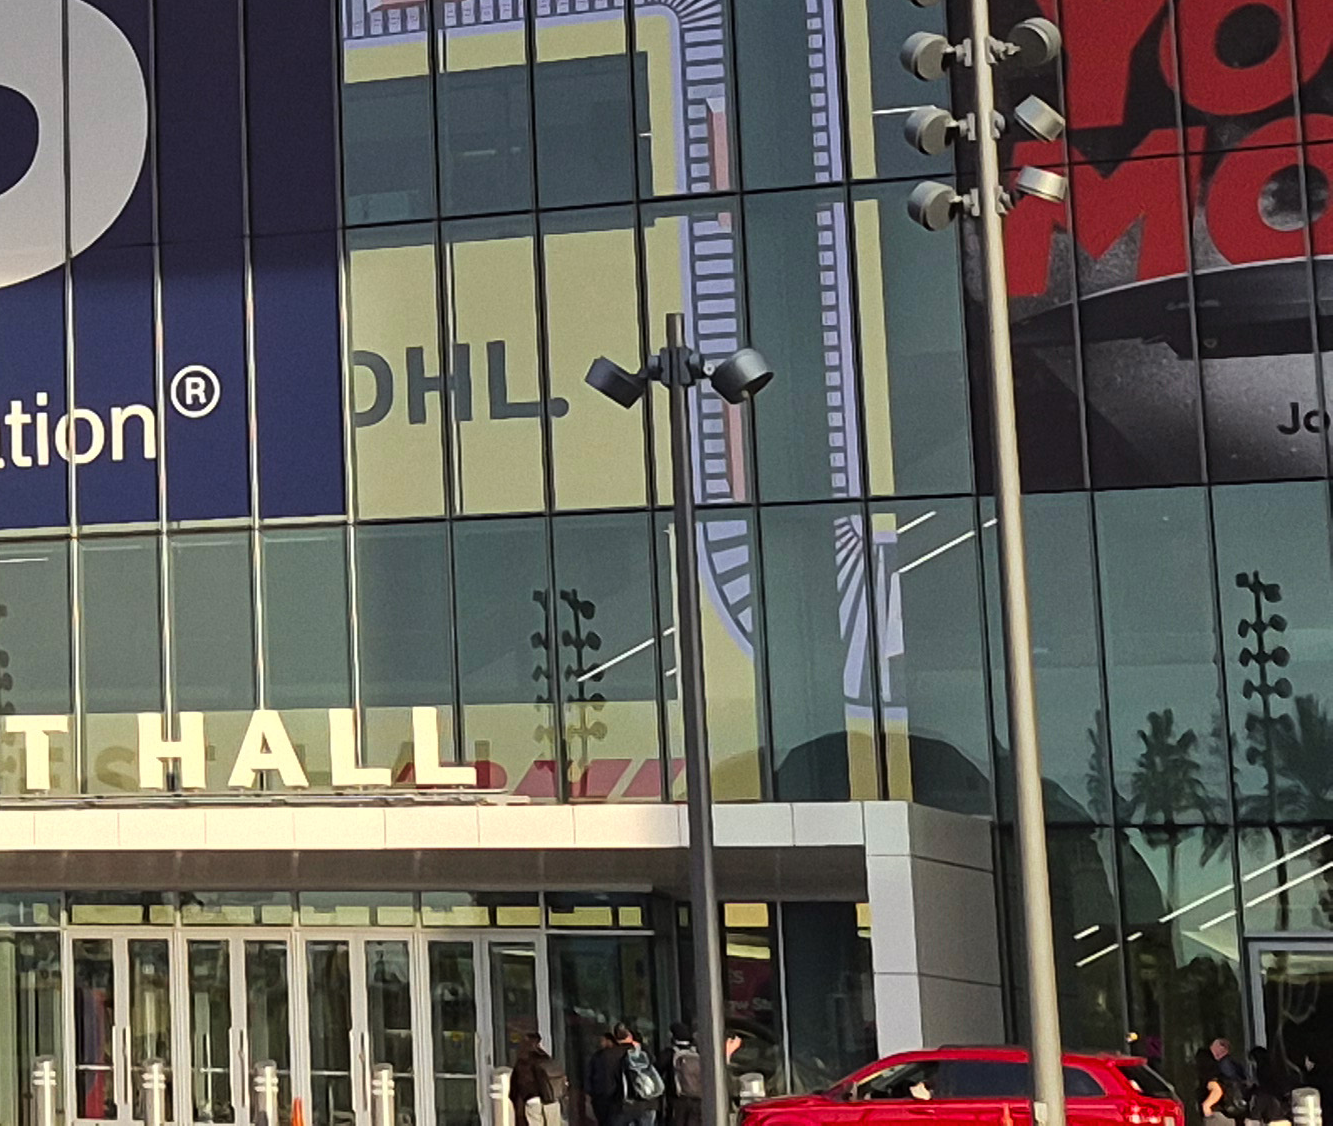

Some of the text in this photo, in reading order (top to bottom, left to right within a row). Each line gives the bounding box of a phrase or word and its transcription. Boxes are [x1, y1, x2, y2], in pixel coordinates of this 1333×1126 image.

[1007, 113, 1333, 298] MO
[1276, 401, 1331, 436] Jo
[137, 707, 478, 789] HALL
